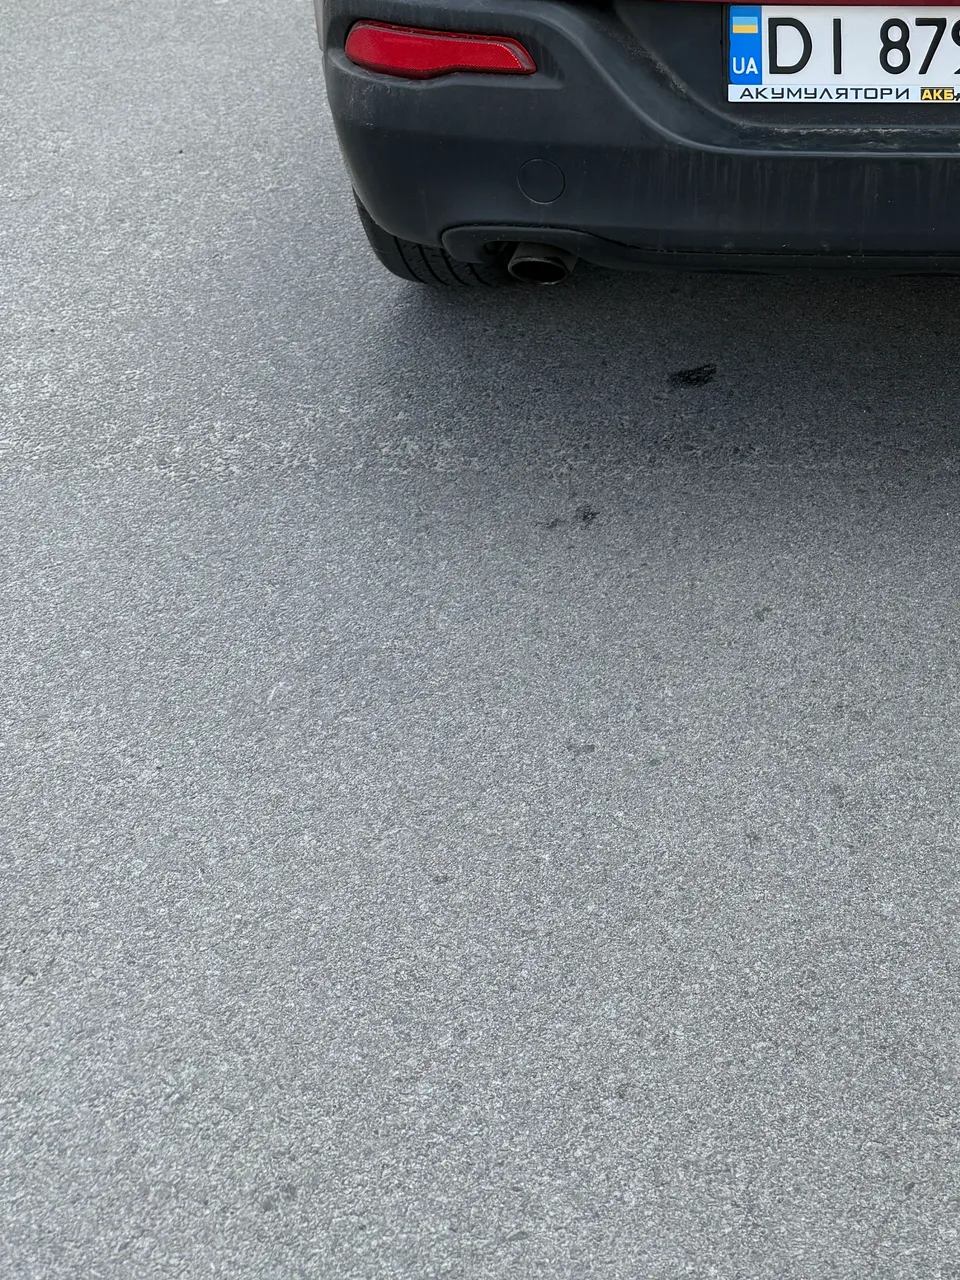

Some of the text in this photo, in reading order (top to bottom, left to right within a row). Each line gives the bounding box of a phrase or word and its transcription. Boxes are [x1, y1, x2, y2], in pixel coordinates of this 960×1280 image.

[768, 17, 842, 75] DI
[732, 57, 759, 75] UA
[739, 87, 910, 100] АКУМУЛЯТОРИ
